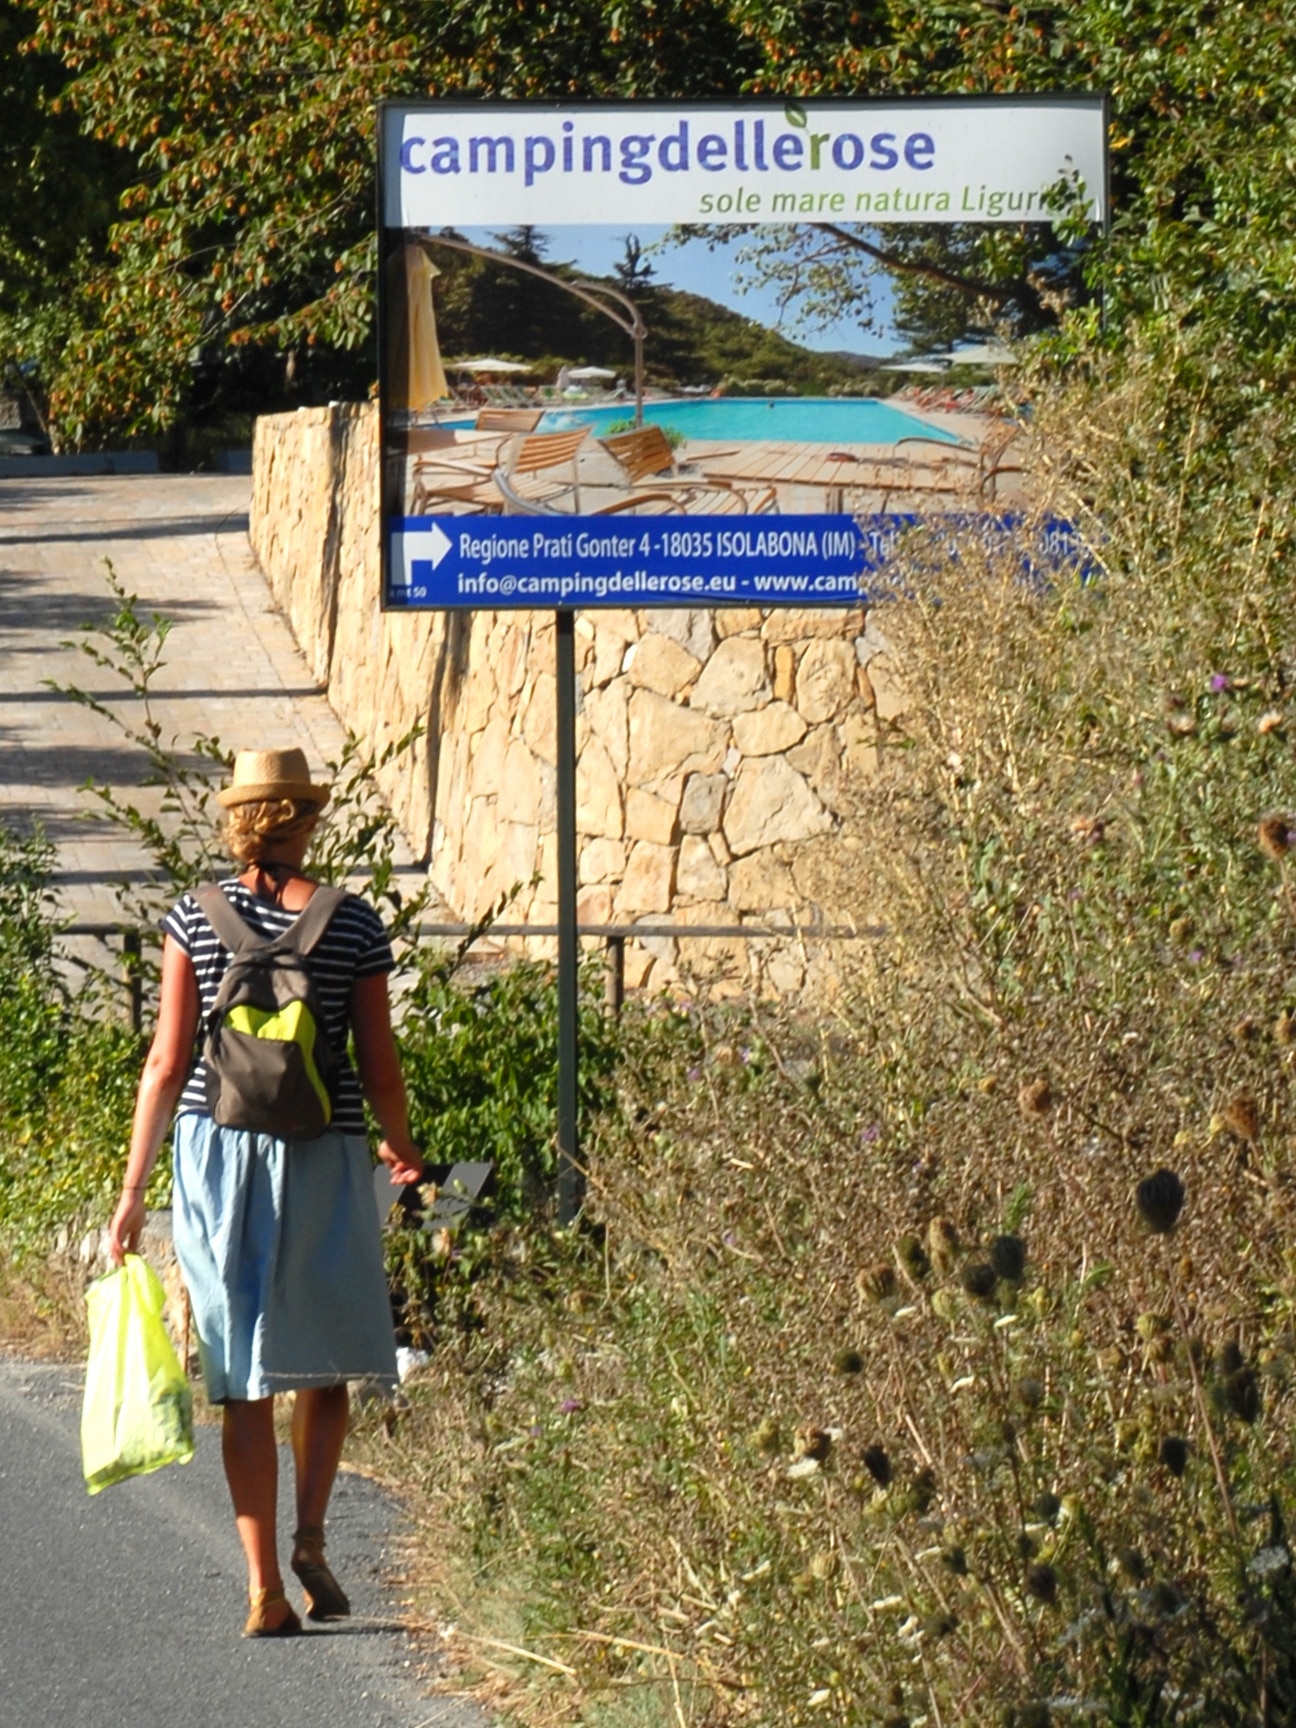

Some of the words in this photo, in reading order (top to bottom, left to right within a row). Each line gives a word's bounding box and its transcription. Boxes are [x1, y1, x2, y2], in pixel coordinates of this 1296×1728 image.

[399, 119, 935, 185] campingdellerose
[699, 186, 761, 214] sole
[771, 191, 845, 213] mare
[855, 188, 951, 212] natura
[459, 532, 529, 564] Regione
[533, 532, 572, 559] Prati
[576, 533, 635, 558] Gonter
[638, 532, 650, 557] 4
[716, 531, 817, 557] ISOLABONA
[821, 530, 855, 560] (IM)
[457, 570, 736, 597] info@campingdellerose.eu
